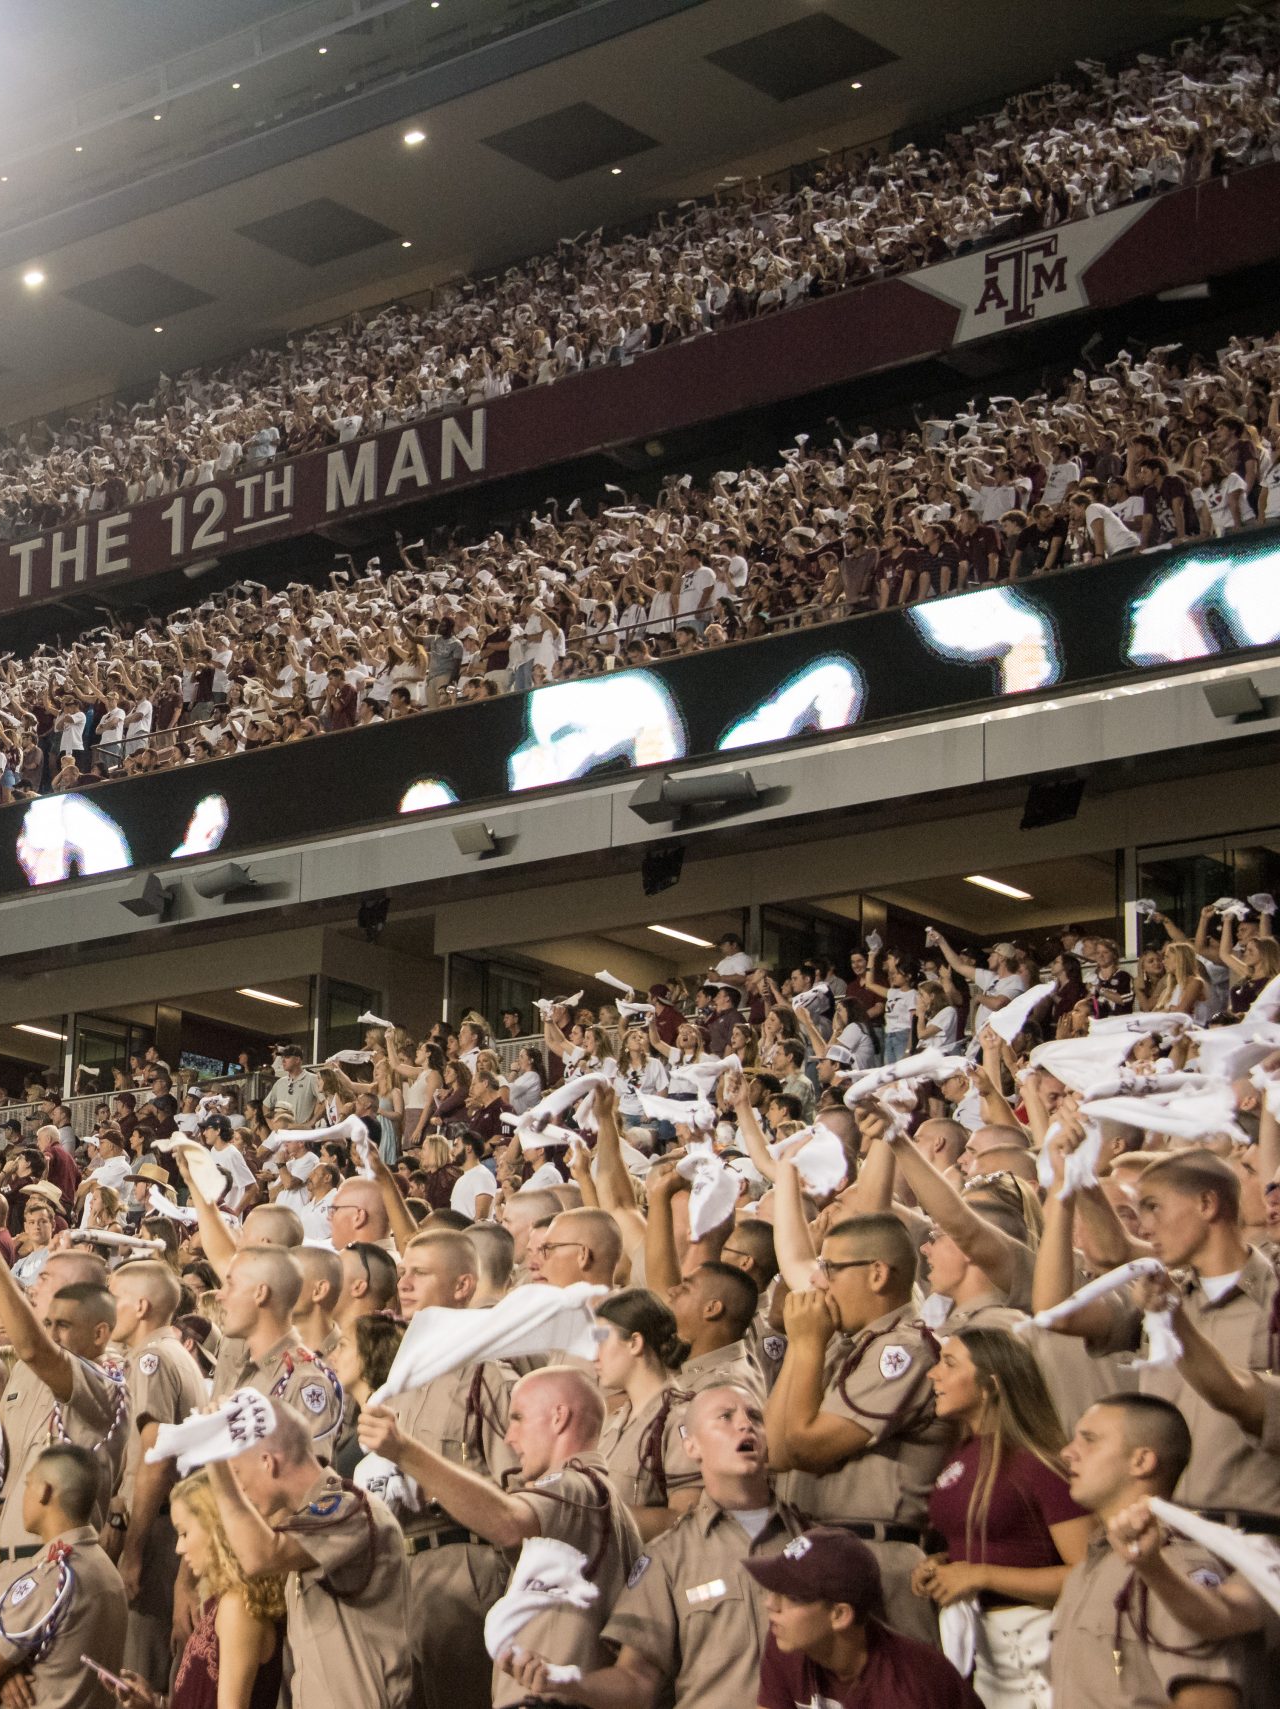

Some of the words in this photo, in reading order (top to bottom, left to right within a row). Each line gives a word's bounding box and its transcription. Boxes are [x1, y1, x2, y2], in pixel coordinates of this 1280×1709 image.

[9, 512, 132, 598] THE
[161, 465, 294, 556] 12TH
[326, 408, 486, 513] MAN
